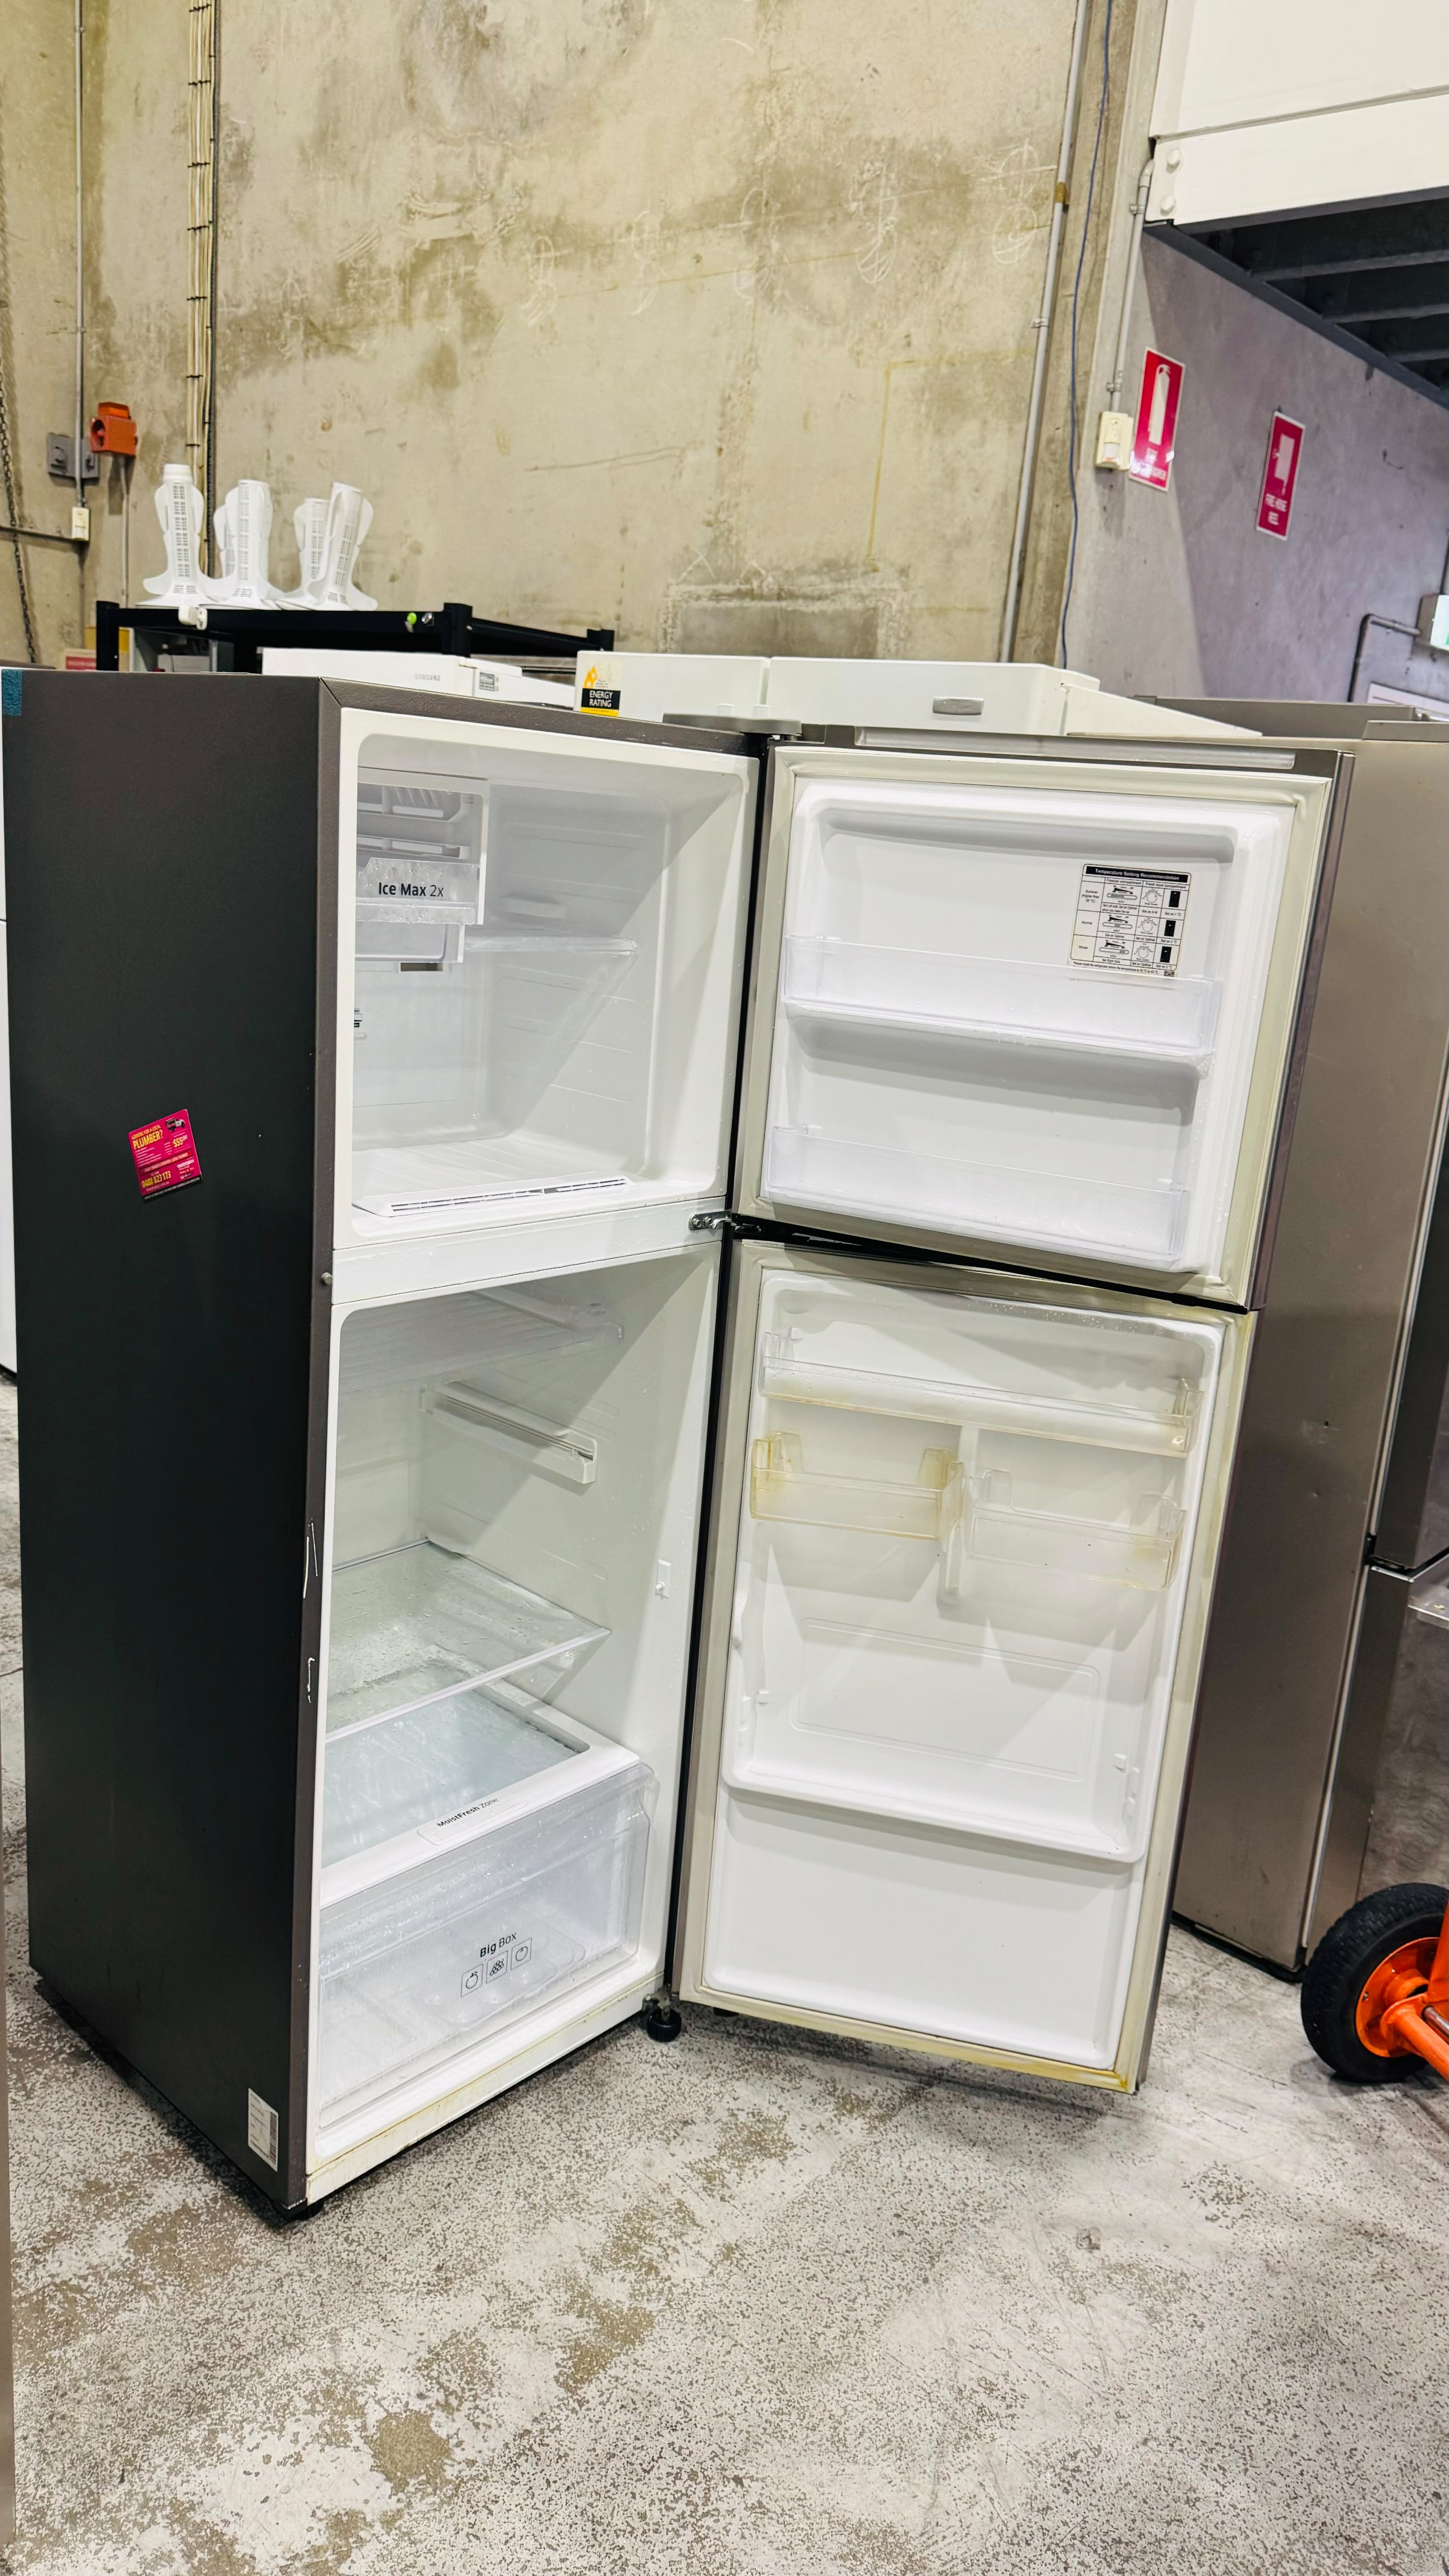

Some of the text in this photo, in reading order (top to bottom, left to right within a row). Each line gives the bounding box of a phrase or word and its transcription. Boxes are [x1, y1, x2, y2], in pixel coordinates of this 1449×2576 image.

[589, 690, 613, 699] ENERGY
[589, 698, 612, 707] RATING
[379, 882, 444, 897] Ice Max 2x
[132, 1129, 164, 1150] PLUMBER?
[437, 1798, 499, 1827] MoistFresh Zone
[480, 1932, 517, 1958] Big Box
